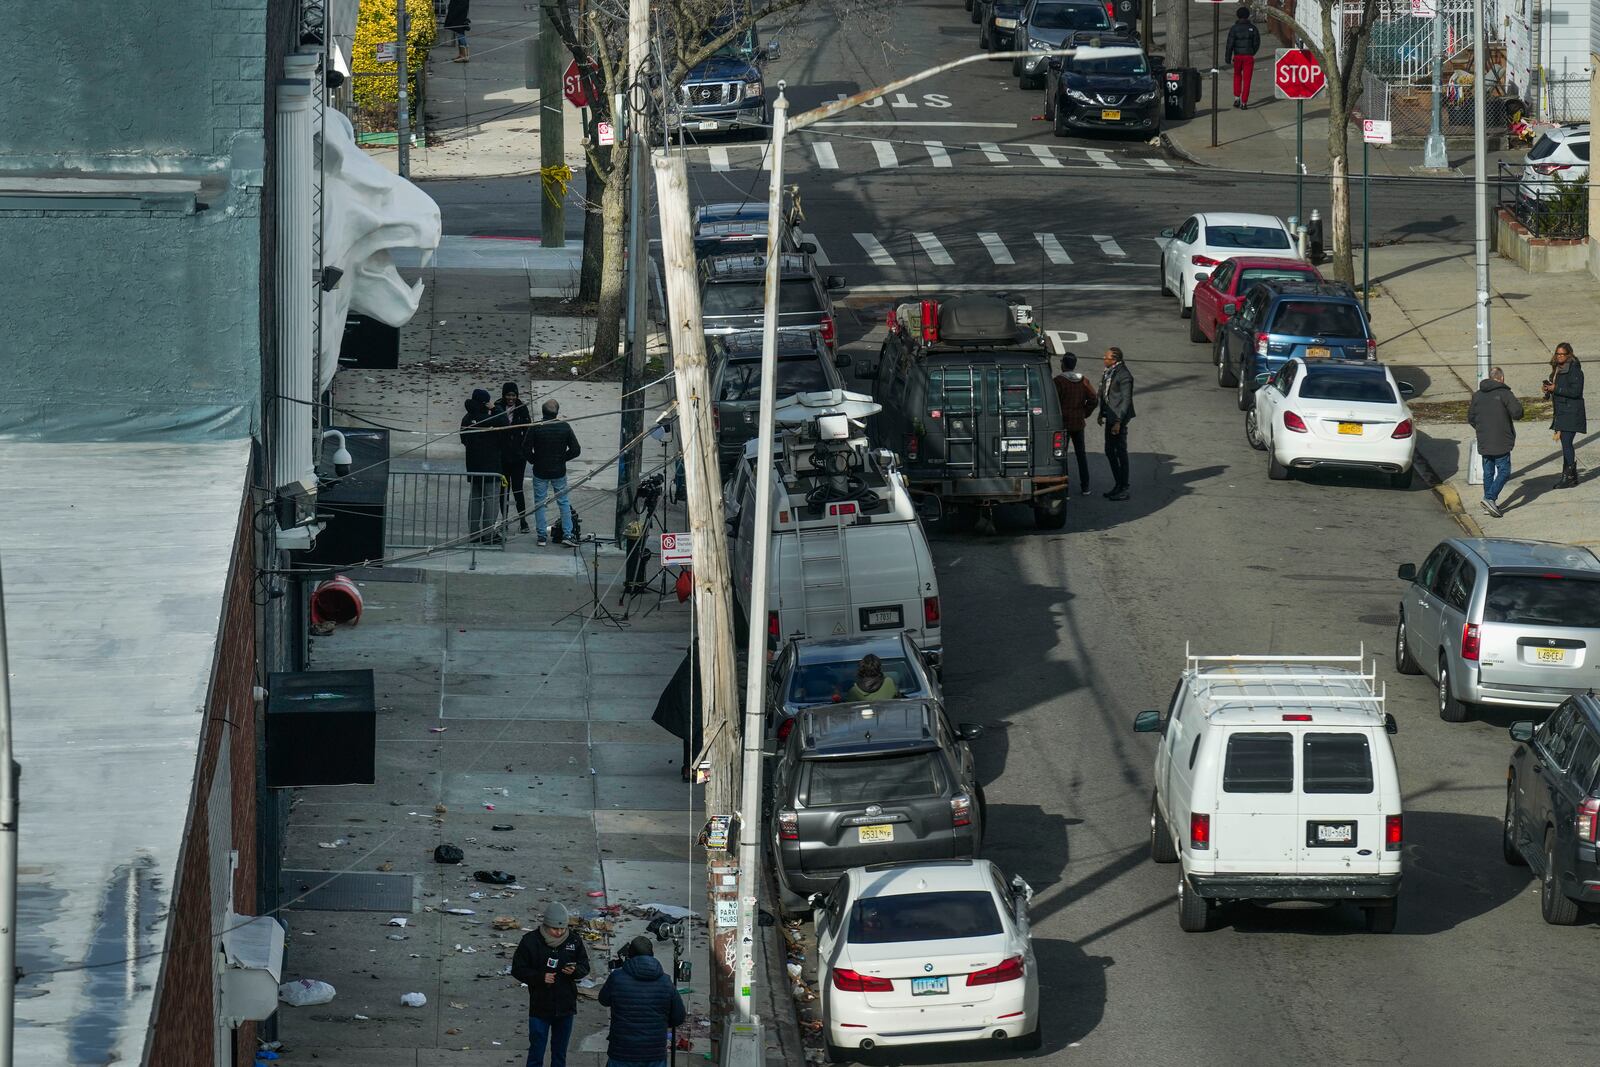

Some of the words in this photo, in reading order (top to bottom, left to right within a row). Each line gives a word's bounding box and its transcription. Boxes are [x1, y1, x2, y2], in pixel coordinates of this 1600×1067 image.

[1279, 65, 1321, 83] STOP
[566, 75, 581, 94] ST
[925, 582, 931, 591] 2
